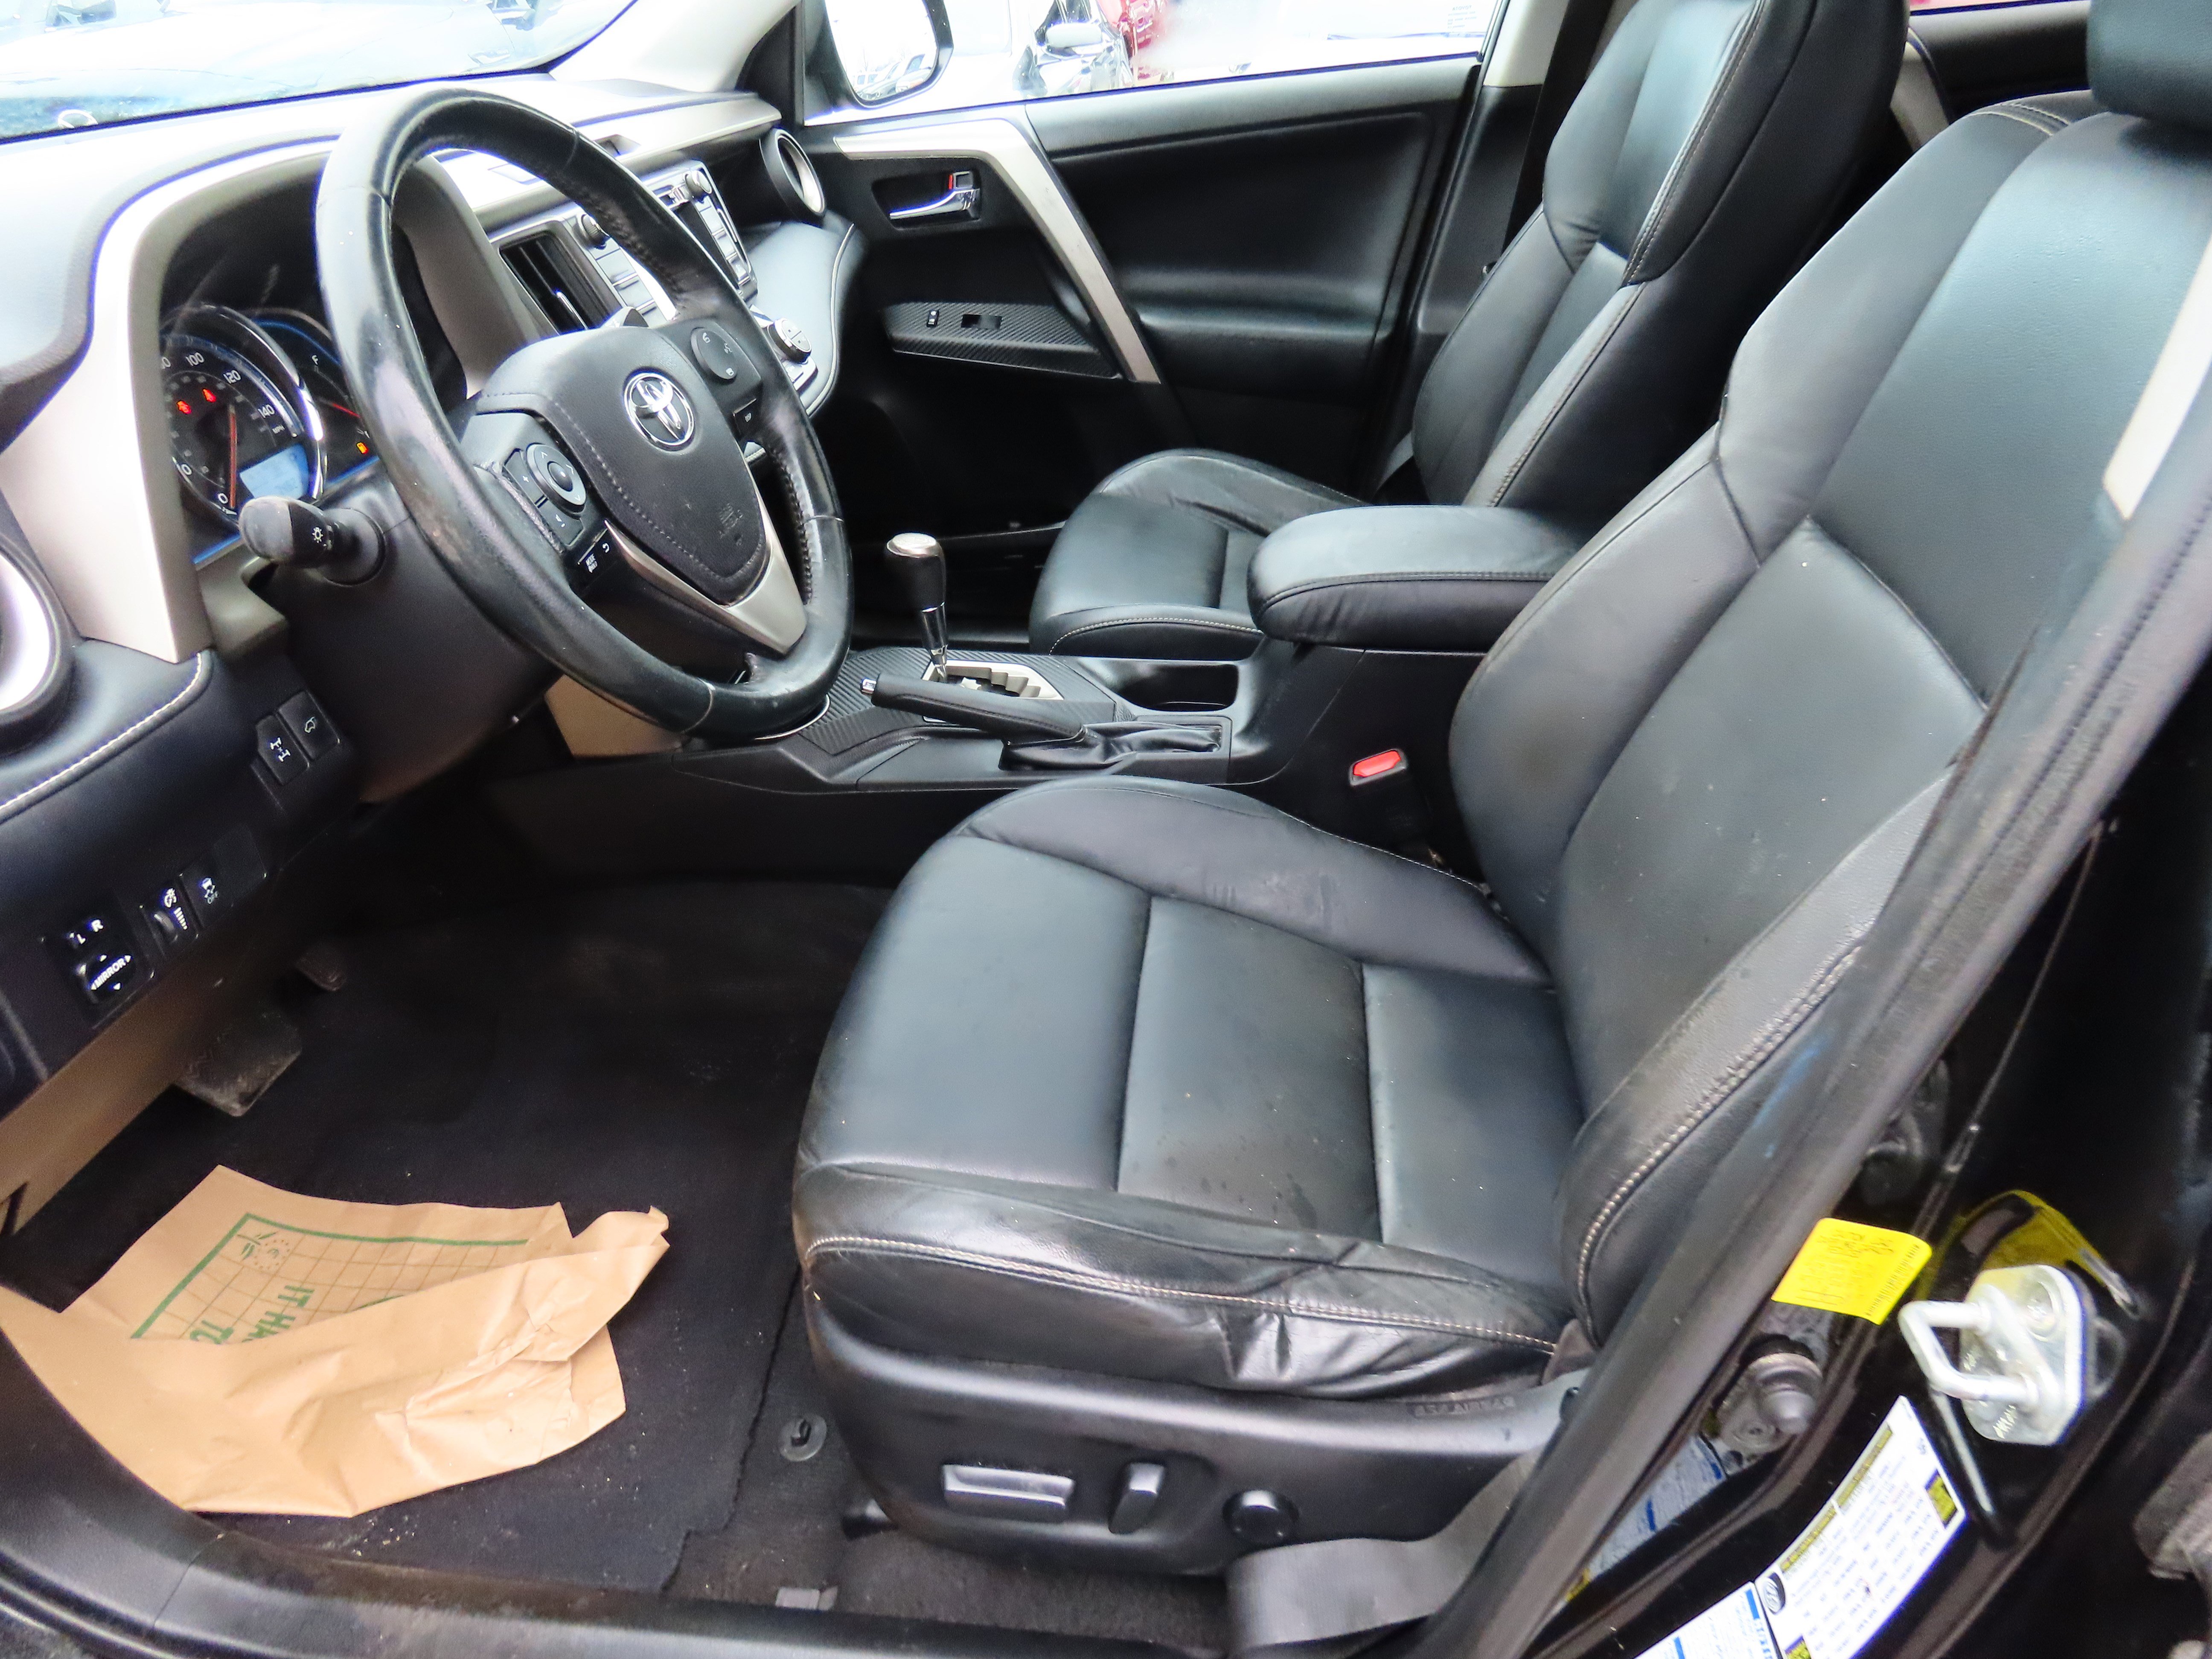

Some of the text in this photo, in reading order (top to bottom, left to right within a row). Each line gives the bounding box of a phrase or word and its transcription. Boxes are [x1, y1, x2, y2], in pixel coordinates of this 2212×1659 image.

[162, 356, 171, 369] 0
[185, 352, 204, 366] 100
[311, 355, 318, 365] F
[223, 370, 242, 384] 120
[257, 404, 275, 419] 140
[272, 425, 285, 434] MPH
[218, 493, 228, 504] 0
[207, 891, 218, 904] OFF
[77, 919, 104, 944] L R
[94, 958, 126, 988] MIRROR
[242, 1285, 315, 1343] IT HA
